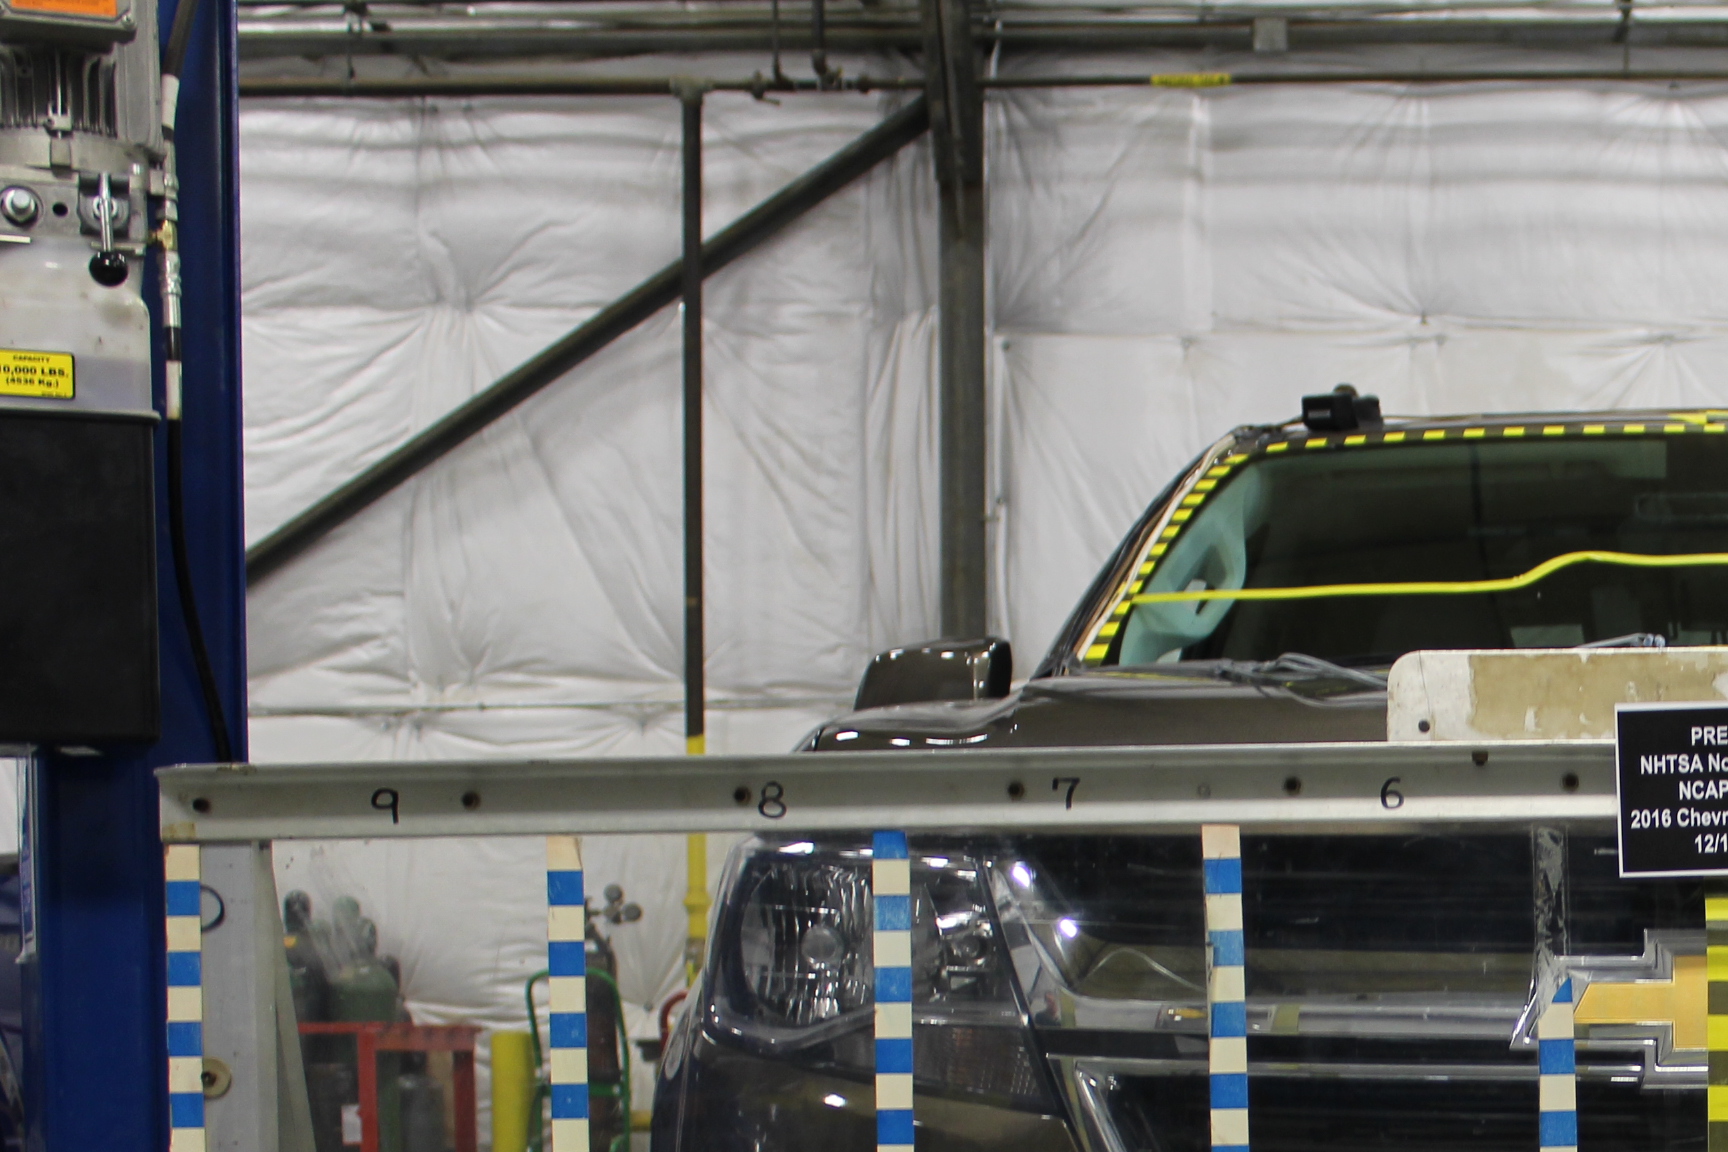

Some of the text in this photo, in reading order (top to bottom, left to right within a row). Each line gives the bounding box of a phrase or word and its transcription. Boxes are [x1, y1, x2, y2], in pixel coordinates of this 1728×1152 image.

[0, 364, 37, 376] 0,000
[1640, 753, 1704, 775] NHTSA
[370, 787, 400, 825] 9
[757, 781, 787, 821] 8
[1052, 777, 1081, 811] 7
[1380, 777, 1405, 811] 6
[1630, 808, 1672, 829] 2016
